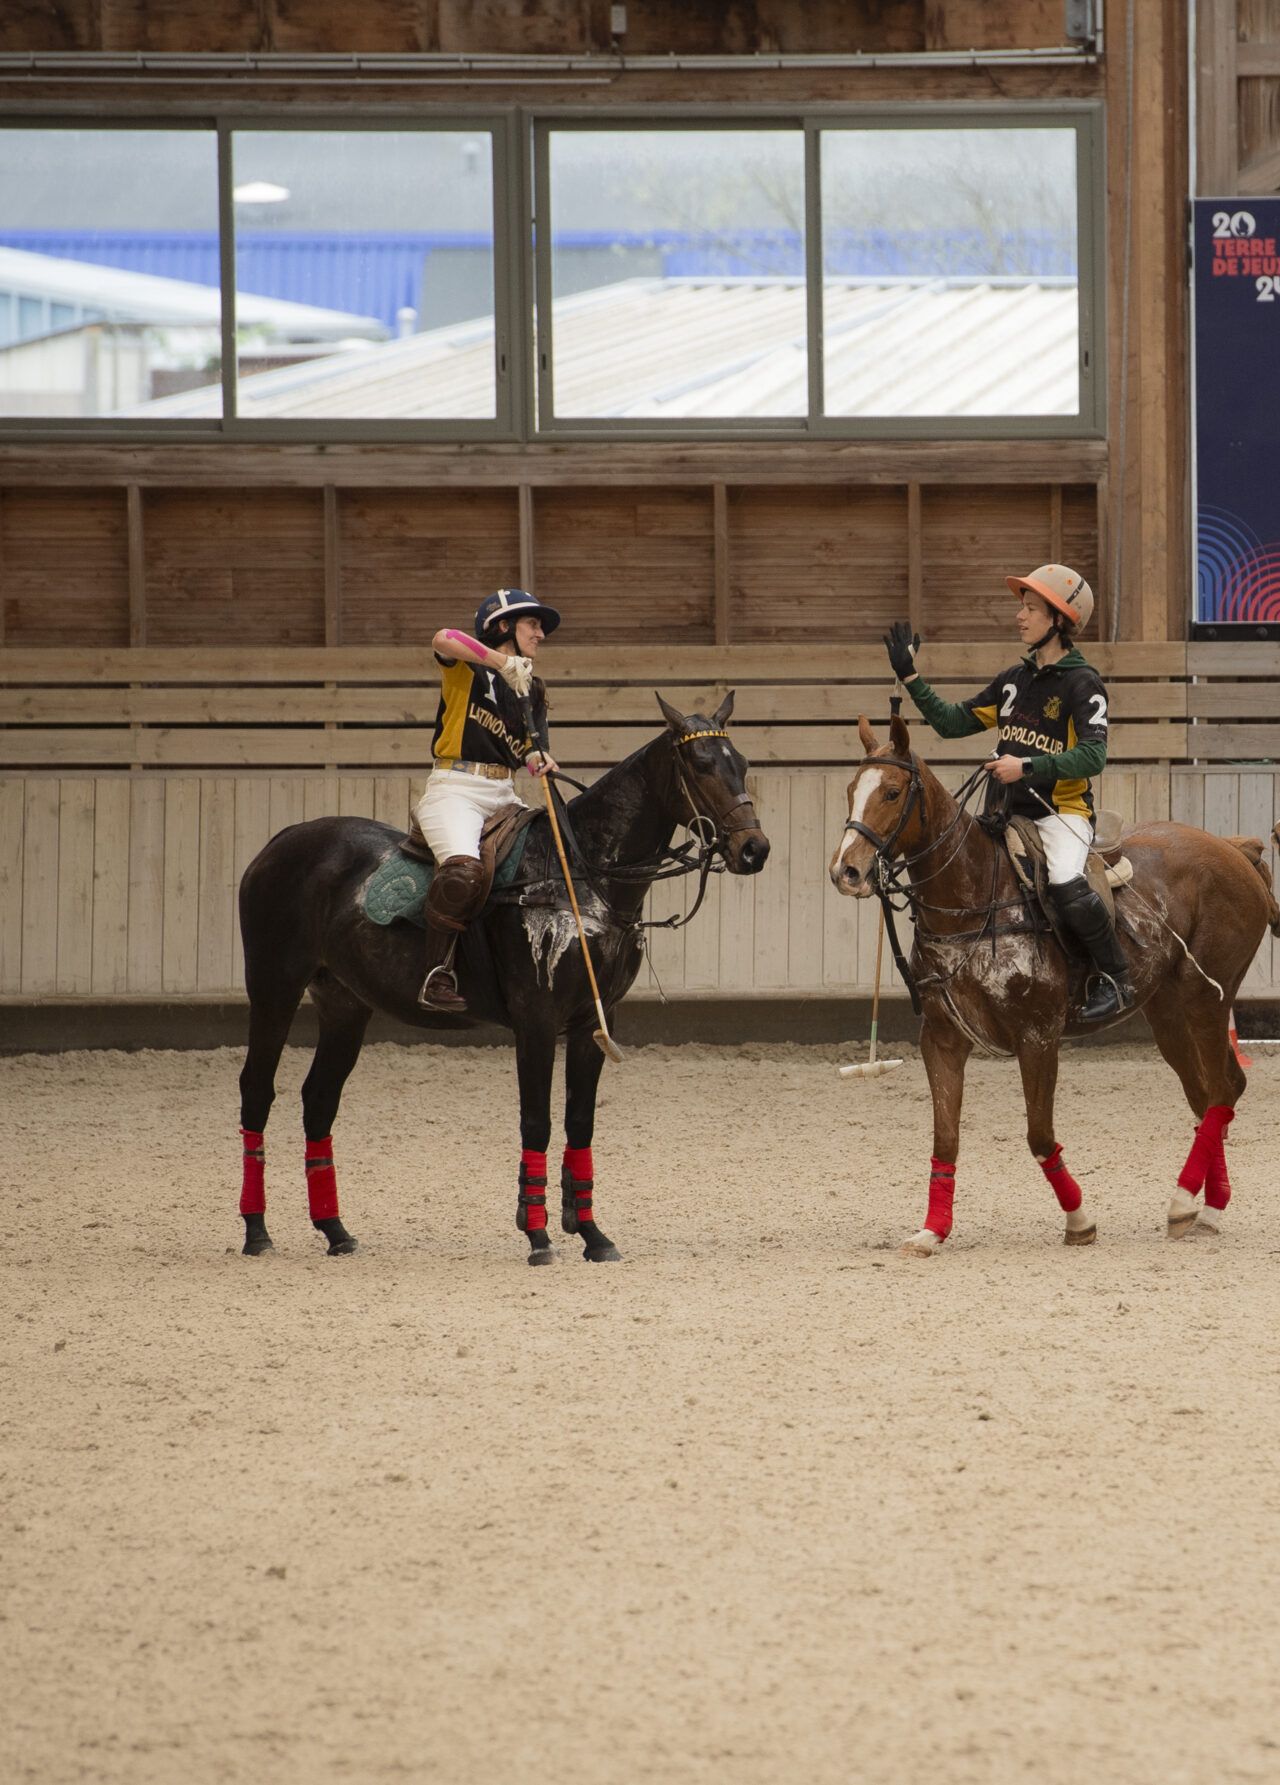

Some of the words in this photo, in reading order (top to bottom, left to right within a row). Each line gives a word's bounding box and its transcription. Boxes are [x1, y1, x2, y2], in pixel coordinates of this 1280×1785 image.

[1212, 211, 1256, 237] 20
[1212, 238, 1276, 256] TERRE
[1212, 257, 1238, 276] DE
[1000, 683, 1018, 717] 2
[1088, 694, 1108, 727] 2
[1010, 726, 1036, 746] POLO
[1035, 734, 1064, 755] CLUB
